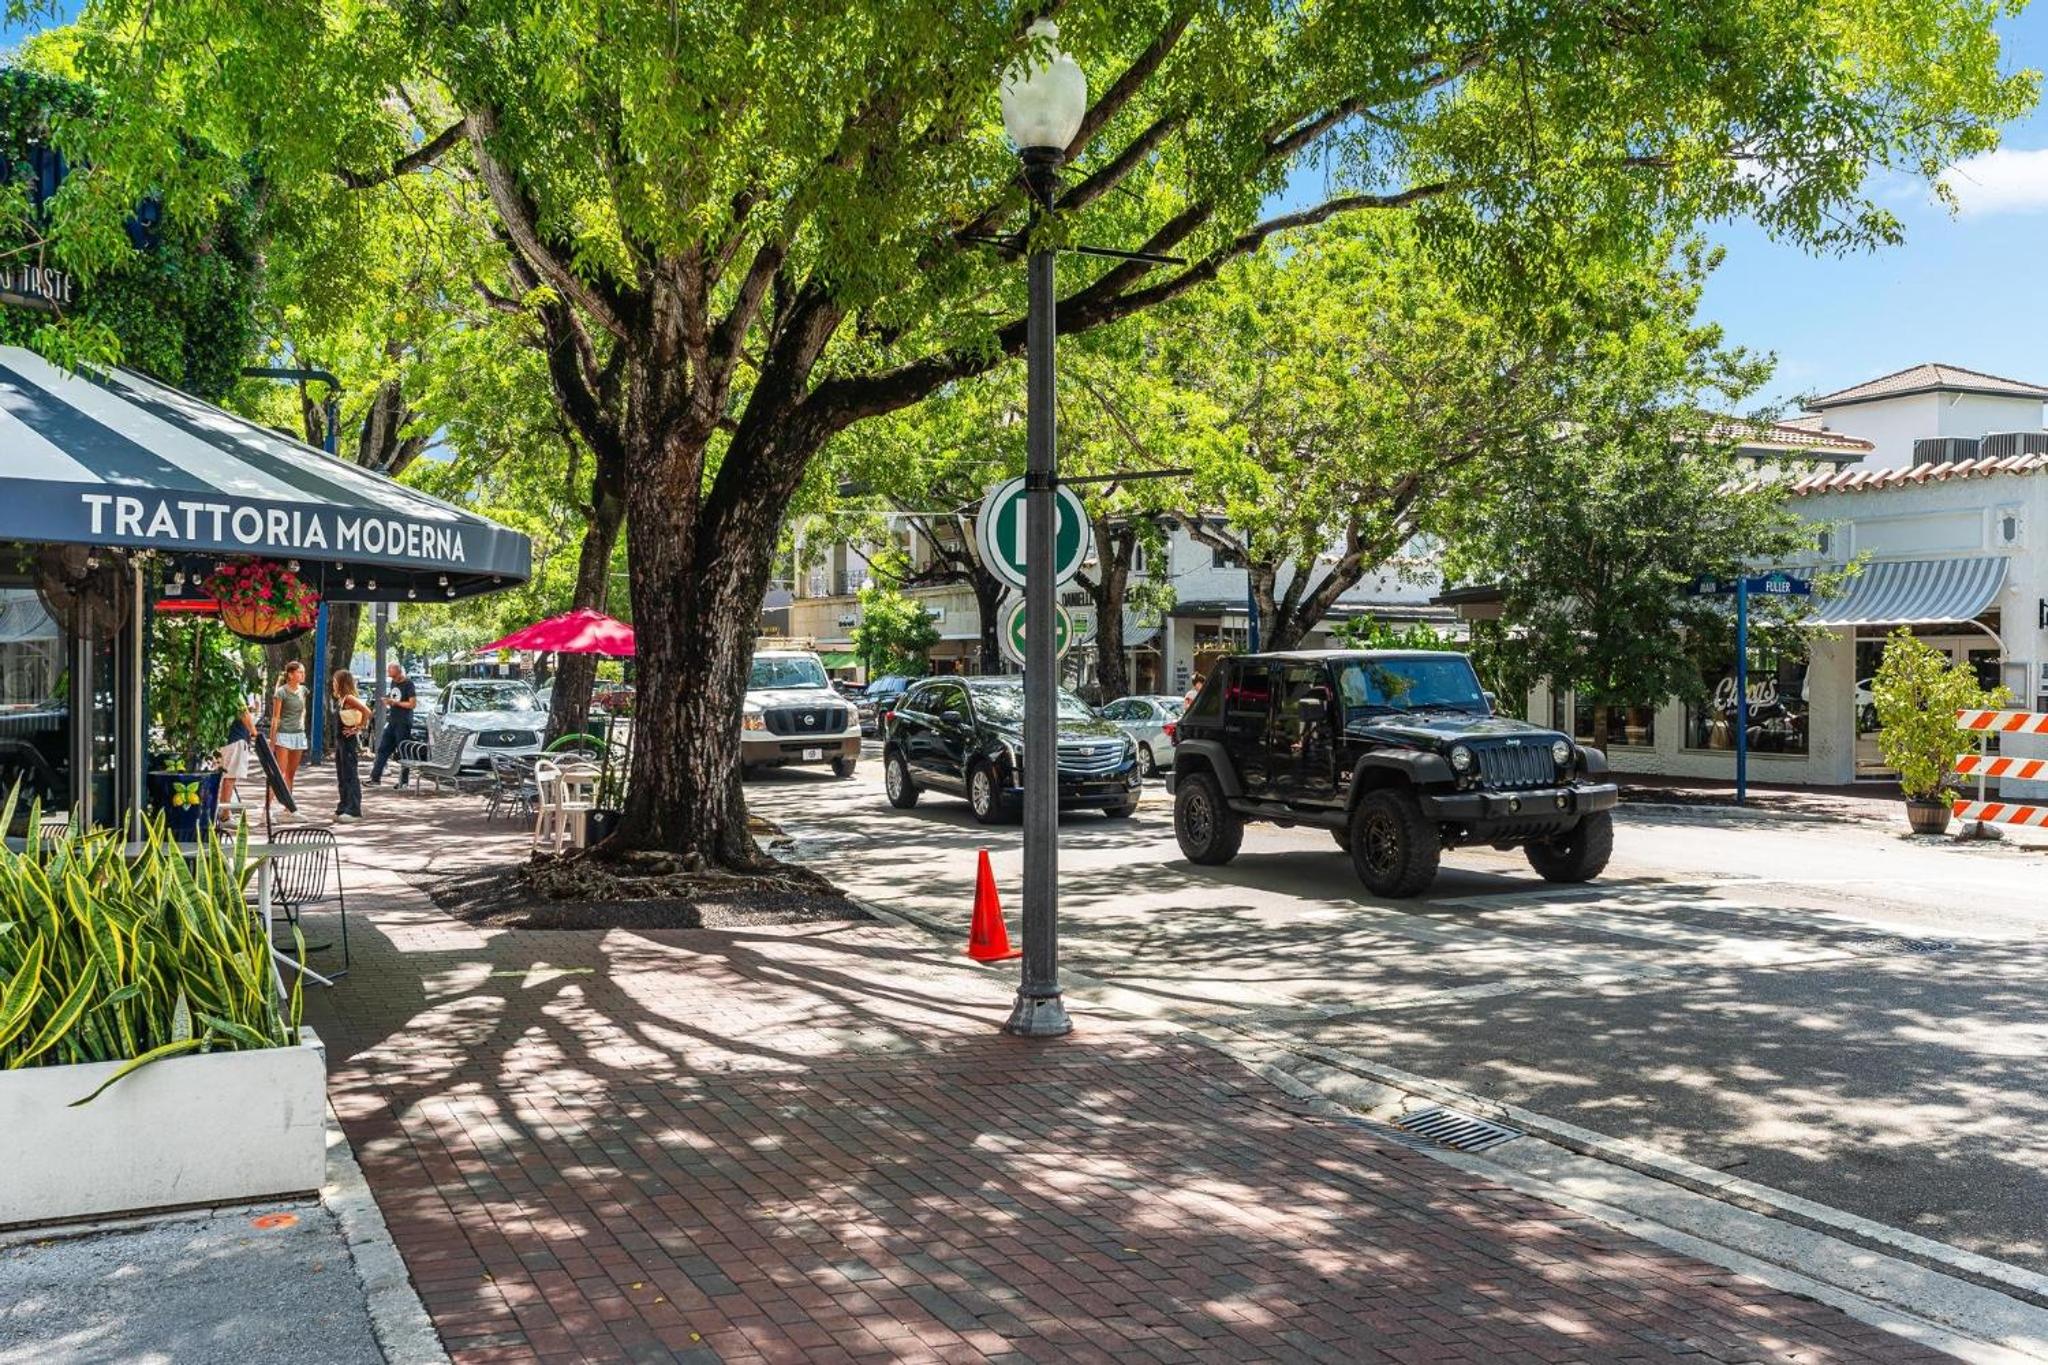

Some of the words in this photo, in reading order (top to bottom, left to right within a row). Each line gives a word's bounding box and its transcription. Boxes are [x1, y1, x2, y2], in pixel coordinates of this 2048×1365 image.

[23, 264, 72, 302] TASTE
[82, 493, 328, 549] TRATTORIA
[336, 515, 466, 562] MODERNA
[1765, 581, 1791, 592] FULLER
